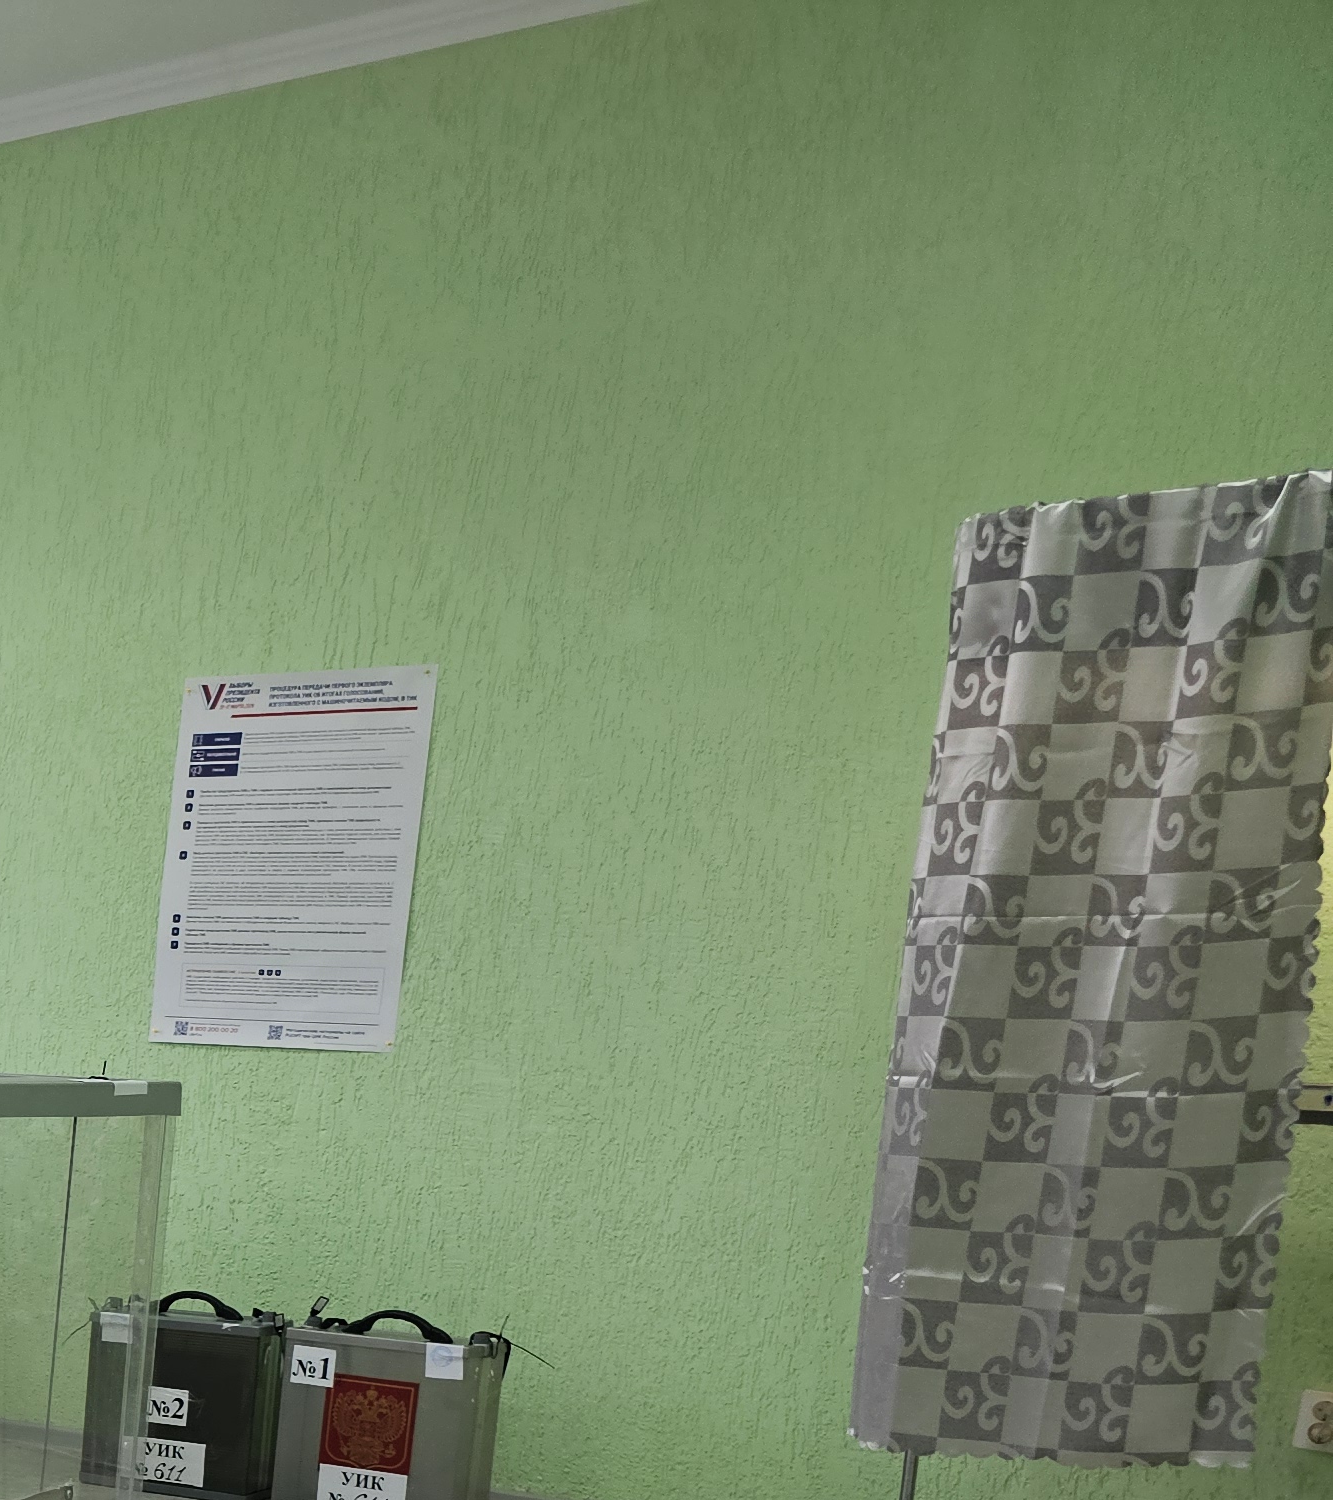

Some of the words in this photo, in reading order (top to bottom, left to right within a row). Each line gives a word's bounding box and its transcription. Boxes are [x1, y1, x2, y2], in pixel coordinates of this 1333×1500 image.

[144, 1441, 185, 1460] УИК
[154, 1462, 187, 1482] 611
[341, 1471, 385, 1491] УИК
